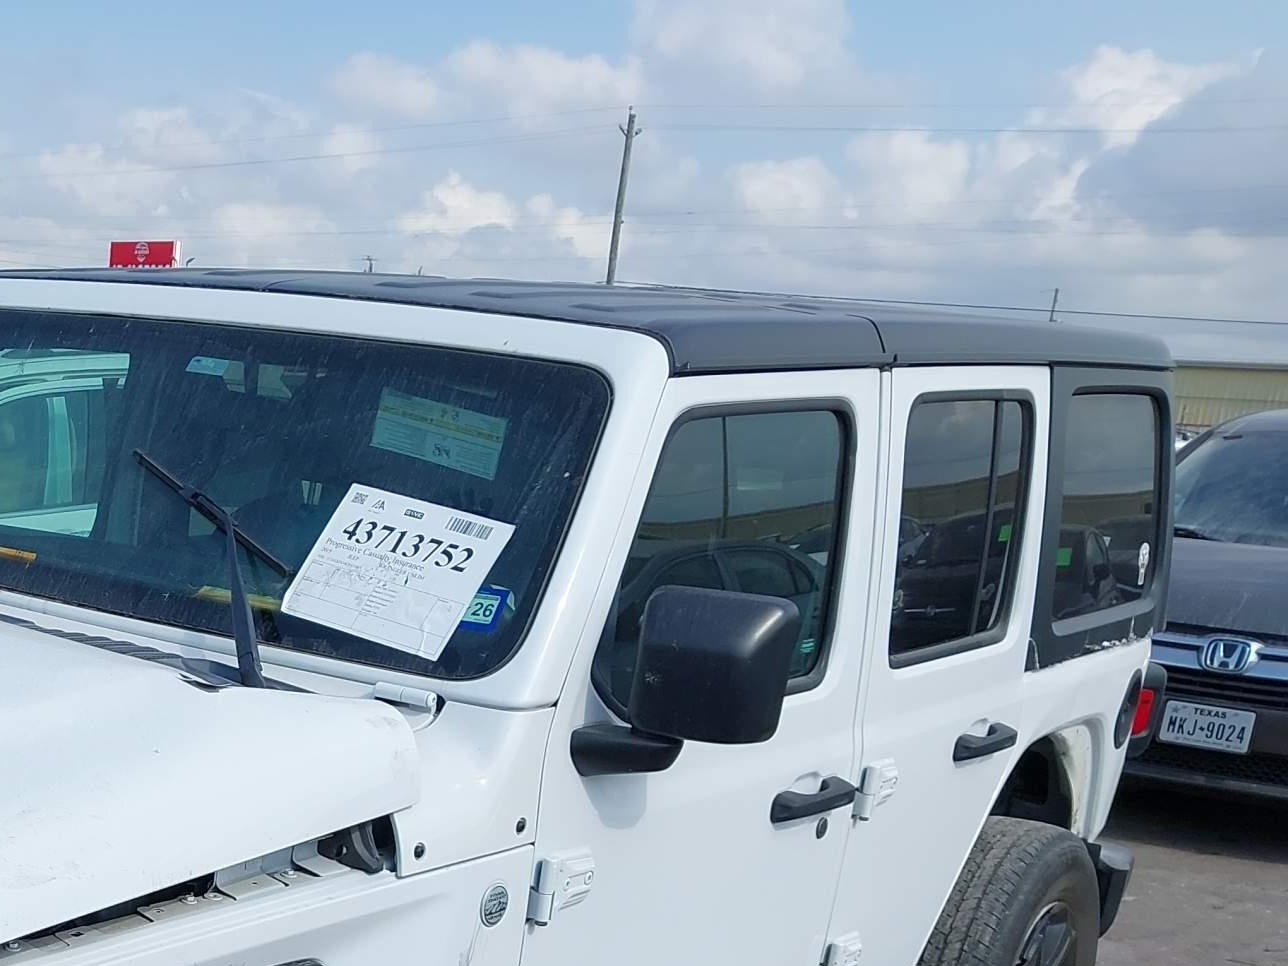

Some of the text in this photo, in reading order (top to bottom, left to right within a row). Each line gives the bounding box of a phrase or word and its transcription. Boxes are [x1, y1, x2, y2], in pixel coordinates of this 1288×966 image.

[325, 537, 361, 554] Progressive
[363, 547, 392, 565] Casualty
[392, 555, 425, 572] Insurance
[342, 518, 474, 573] 43713752
[471, 602, 495, 618] 26
[1194, 707, 1227, 719] TEXAS
